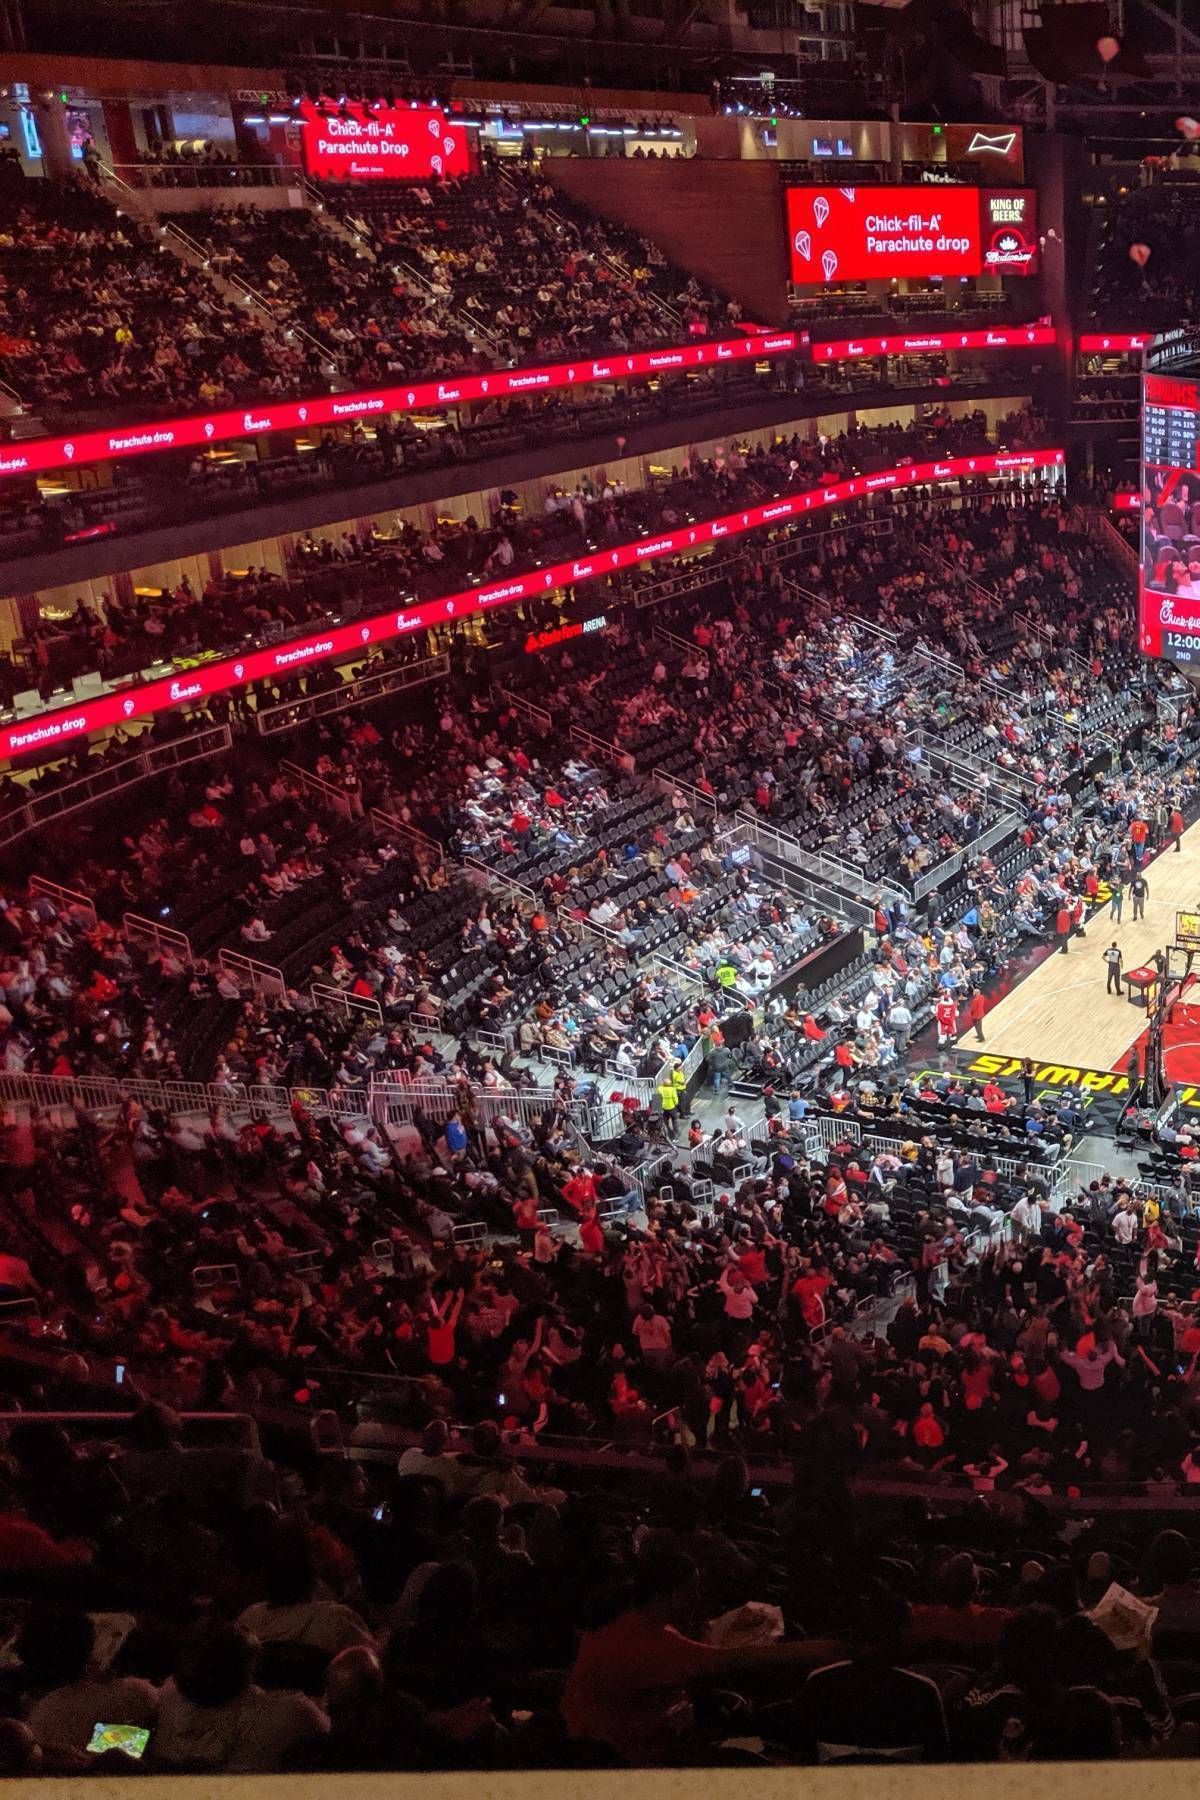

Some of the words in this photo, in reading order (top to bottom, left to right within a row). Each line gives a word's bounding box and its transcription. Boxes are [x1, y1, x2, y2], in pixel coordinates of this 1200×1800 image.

[328, 121, 395, 137] Chick-fil-A
[318, 139, 379, 154] Parachute
[380, 142, 409, 157] Drop
[990, 199, 1012, 210] KING
[1013, 199, 1025, 210] OF
[865, 215, 941, 232] Chick-fil-A
[867, 236, 933, 252] Parachute
[936, 235, 970, 254] drop
[986, 251, 1032, 264] Budweiser
[509, 376, 536, 387] Parachute
[333, 401, 367, 414] Parachute
[109, 434, 153, 450] Parachute
[478, 588, 507, 604] Parachute
[507, 583, 524, 598] drop
[583, 616, 606, 633] ARENA
[1167, 632, 1200, 650] 12:00
[276, 647, 314, 666] Parachute
[315, 641, 333, 656] drop
[1176, 651, 1191, 661] 2ND
[10, 724, 61, 748] Parachute
[62, 717, 86, 732] drop
